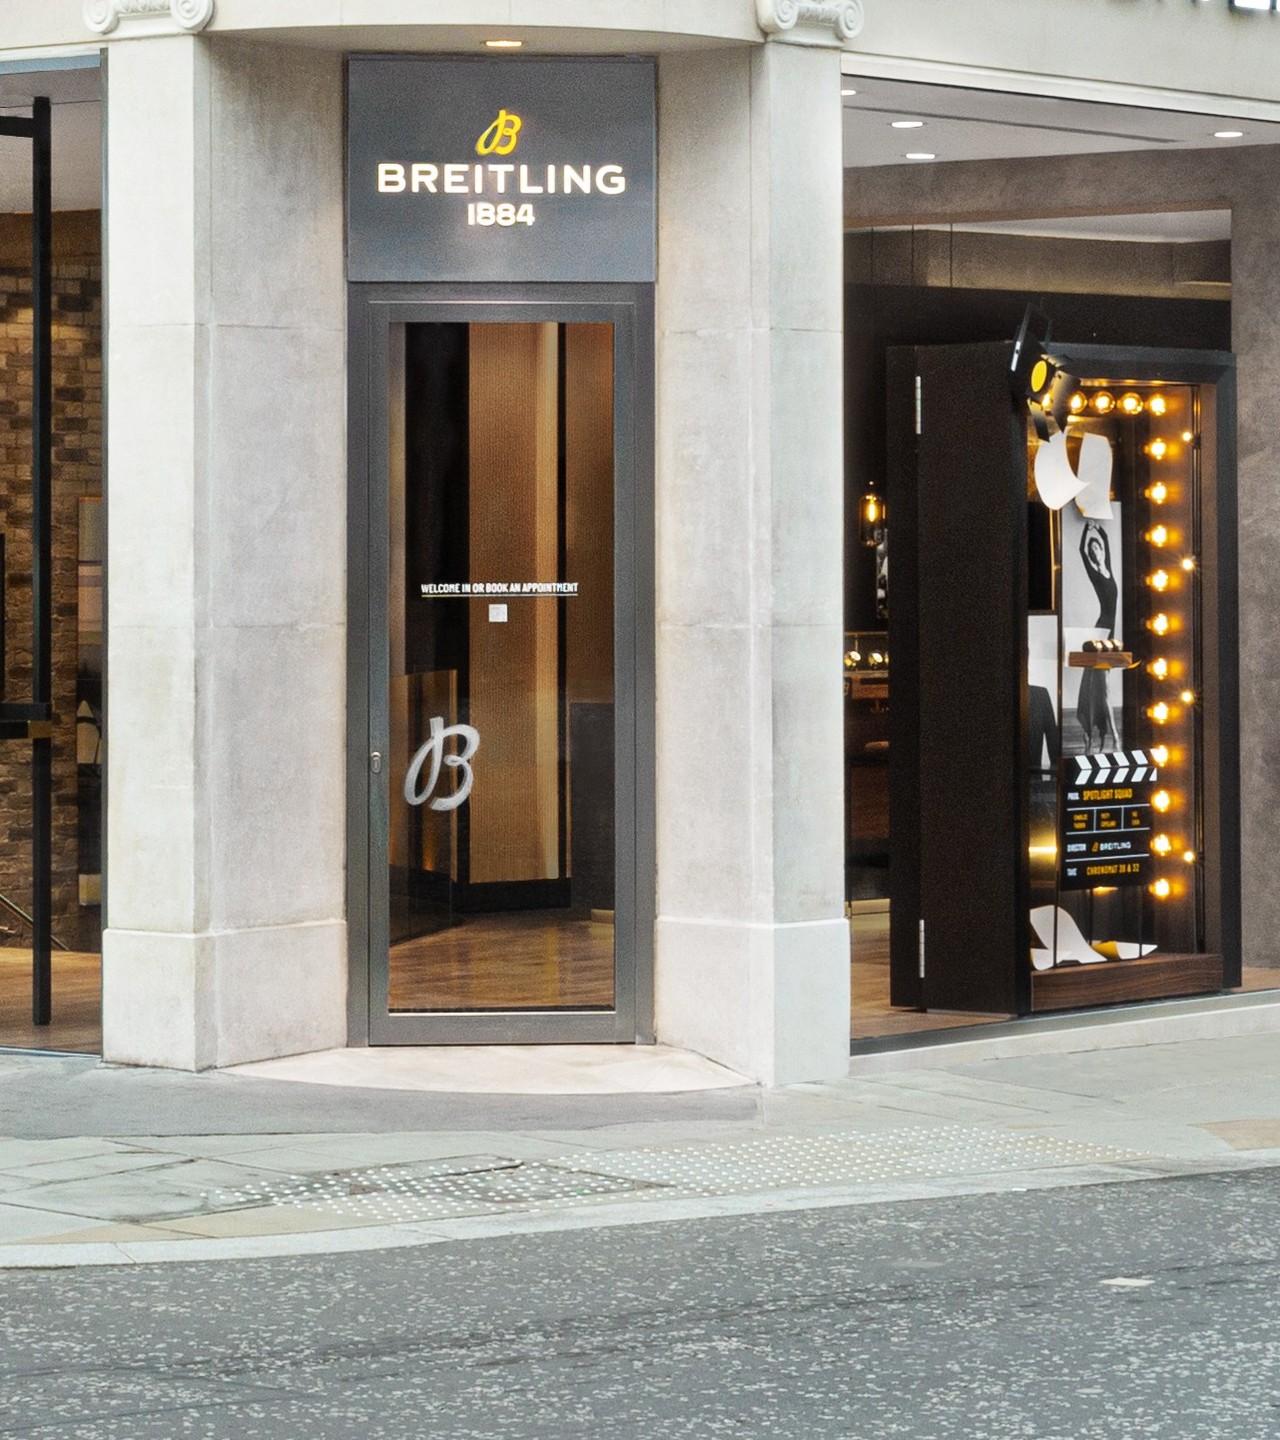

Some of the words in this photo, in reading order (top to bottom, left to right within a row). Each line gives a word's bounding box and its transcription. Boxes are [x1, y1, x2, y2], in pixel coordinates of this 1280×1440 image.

[377, 162, 626, 195] BREITLING
[467, 201, 535, 227] 1884
[421, 583, 460, 594] WELCOME
[462, 583, 471, 593] IN
[472, 583, 484, 593] OR
[486, 582, 508, 593] BOOK
[509, 582, 521, 593] AN
[522, 582, 579, 593] APPOINTMENT
[1083, 789, 1113, 801] SPOTLIGHT
[1100, 841, 1132, 851] BREITLING
